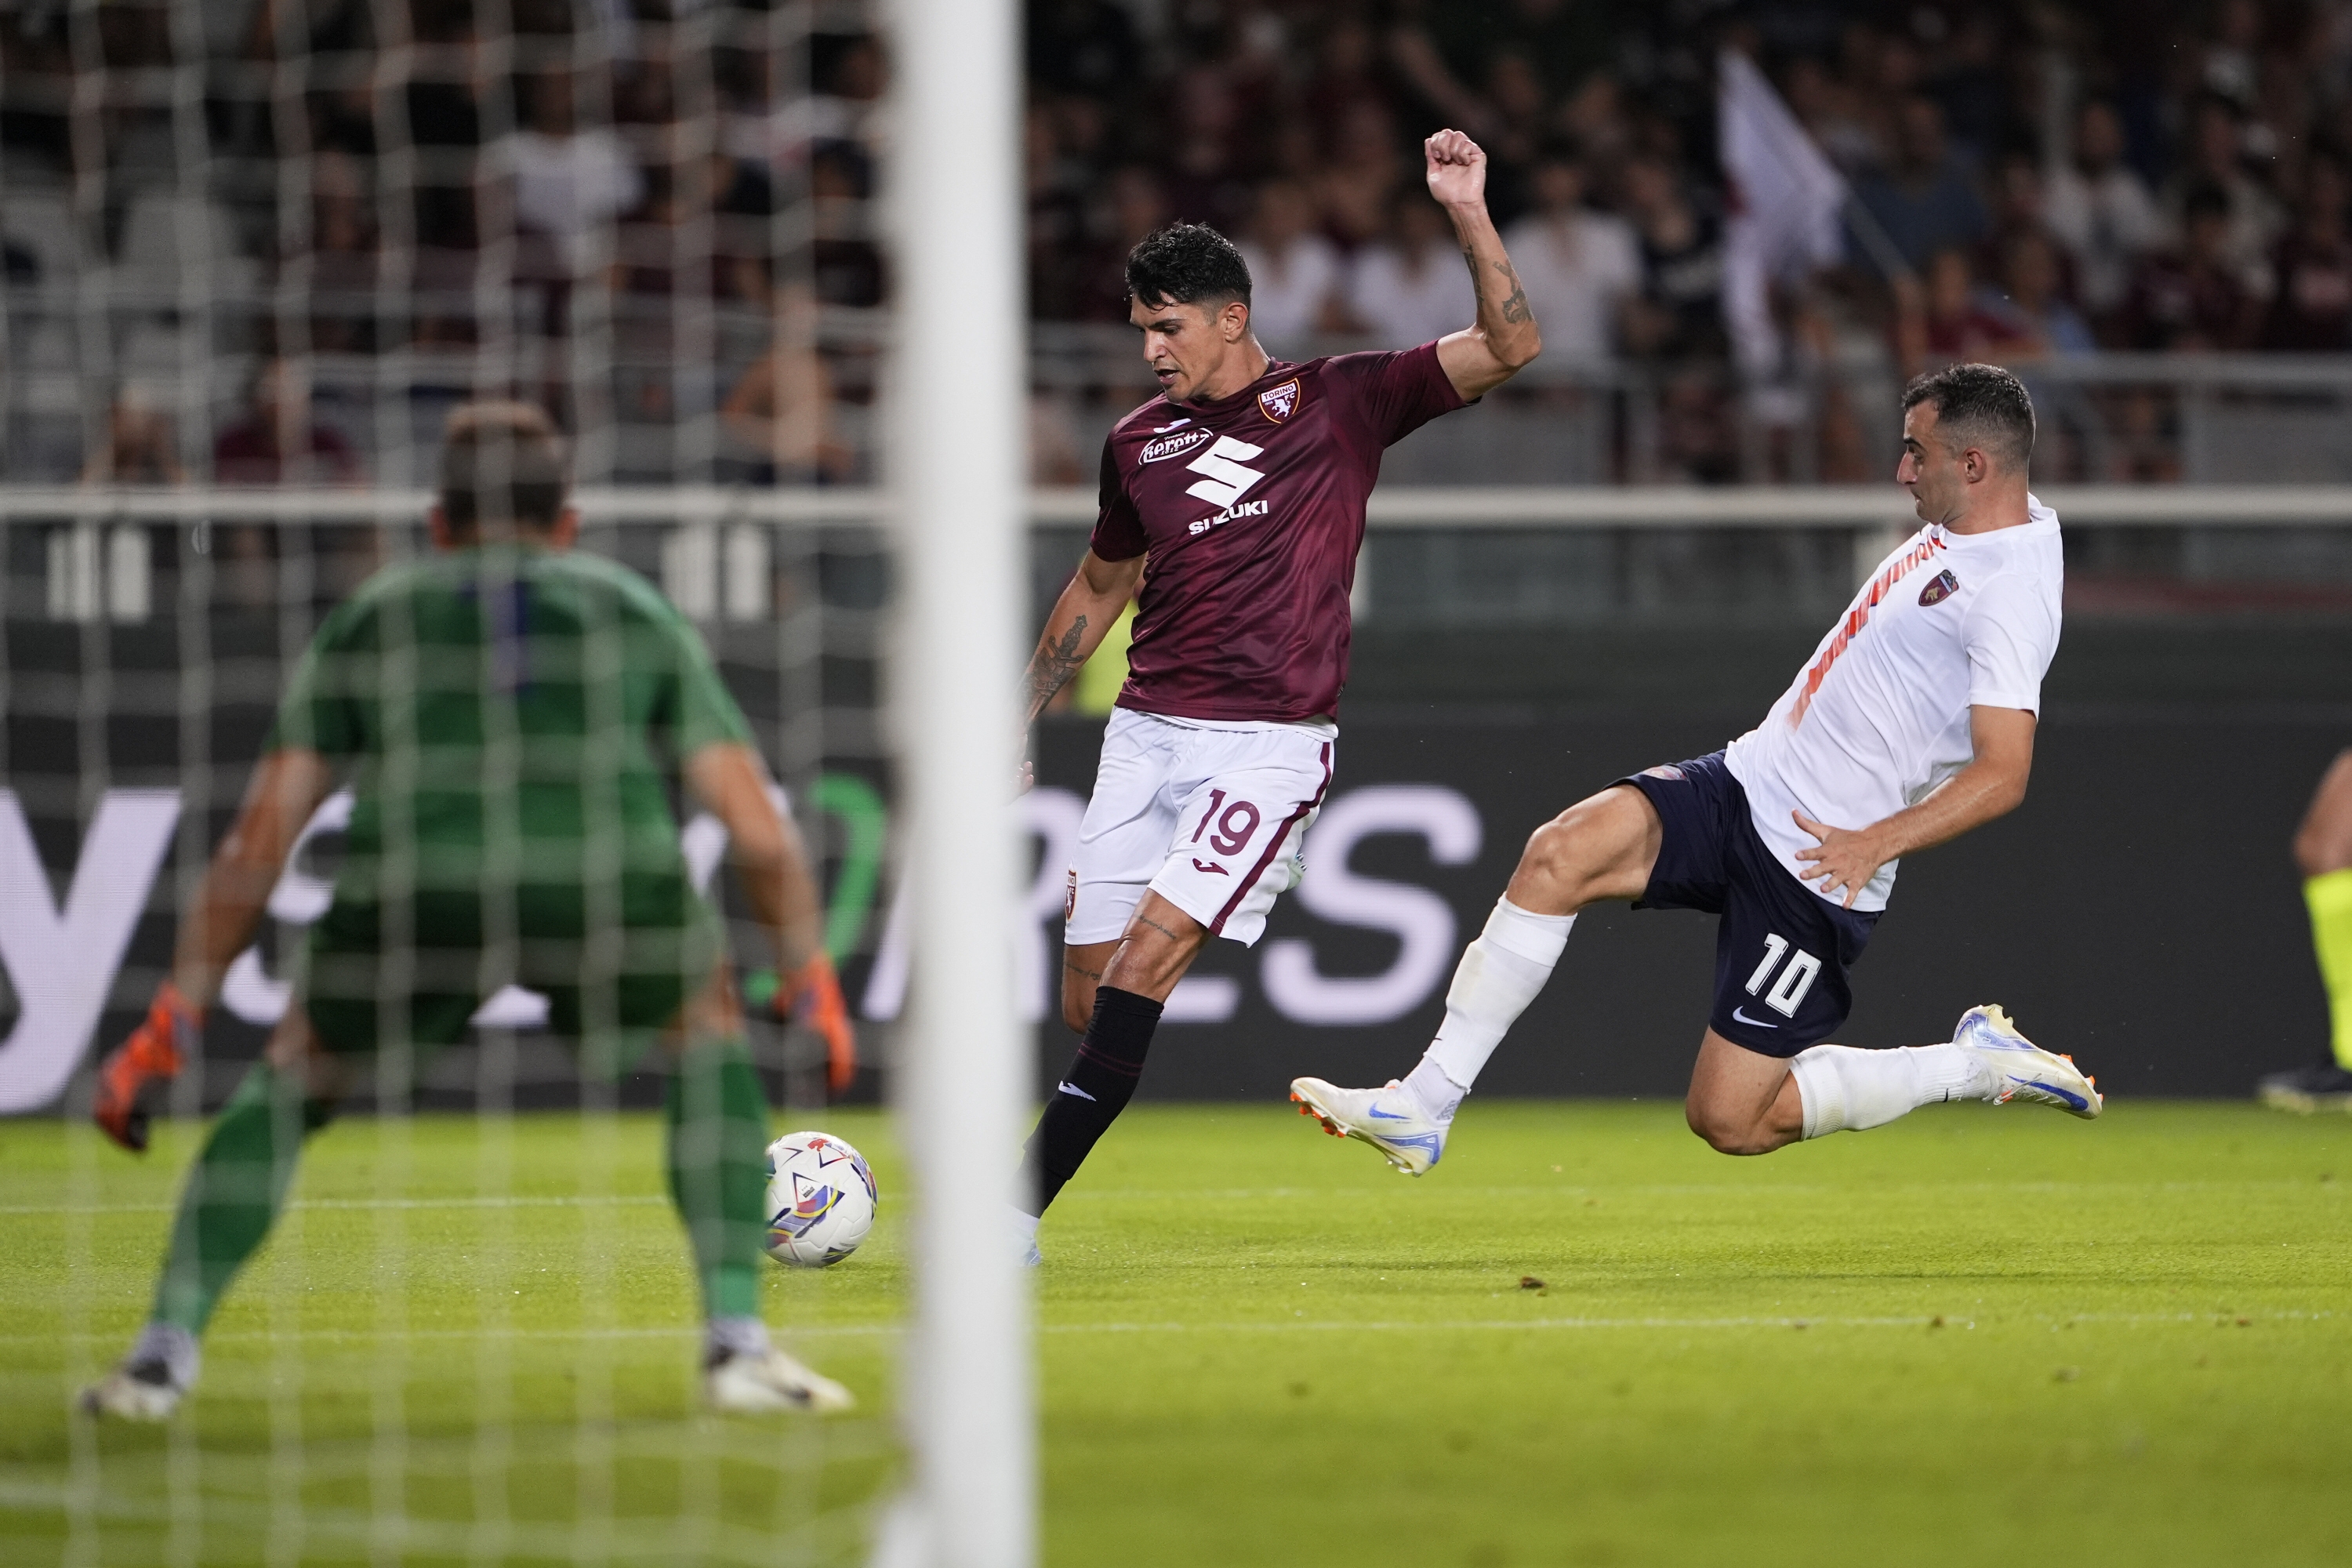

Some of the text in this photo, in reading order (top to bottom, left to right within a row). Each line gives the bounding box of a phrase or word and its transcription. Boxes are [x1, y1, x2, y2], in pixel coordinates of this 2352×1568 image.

[1263, 385, 1294, 400] TORINO
[1284, 392, 1296, 401] FC
[1160, 446, 1179, 456] 1812
[1188, 499, 1269, 535] SUZUKI
[1191, 789, 1261, 856] 19
[1745, 932, 1822, 1018] 10
